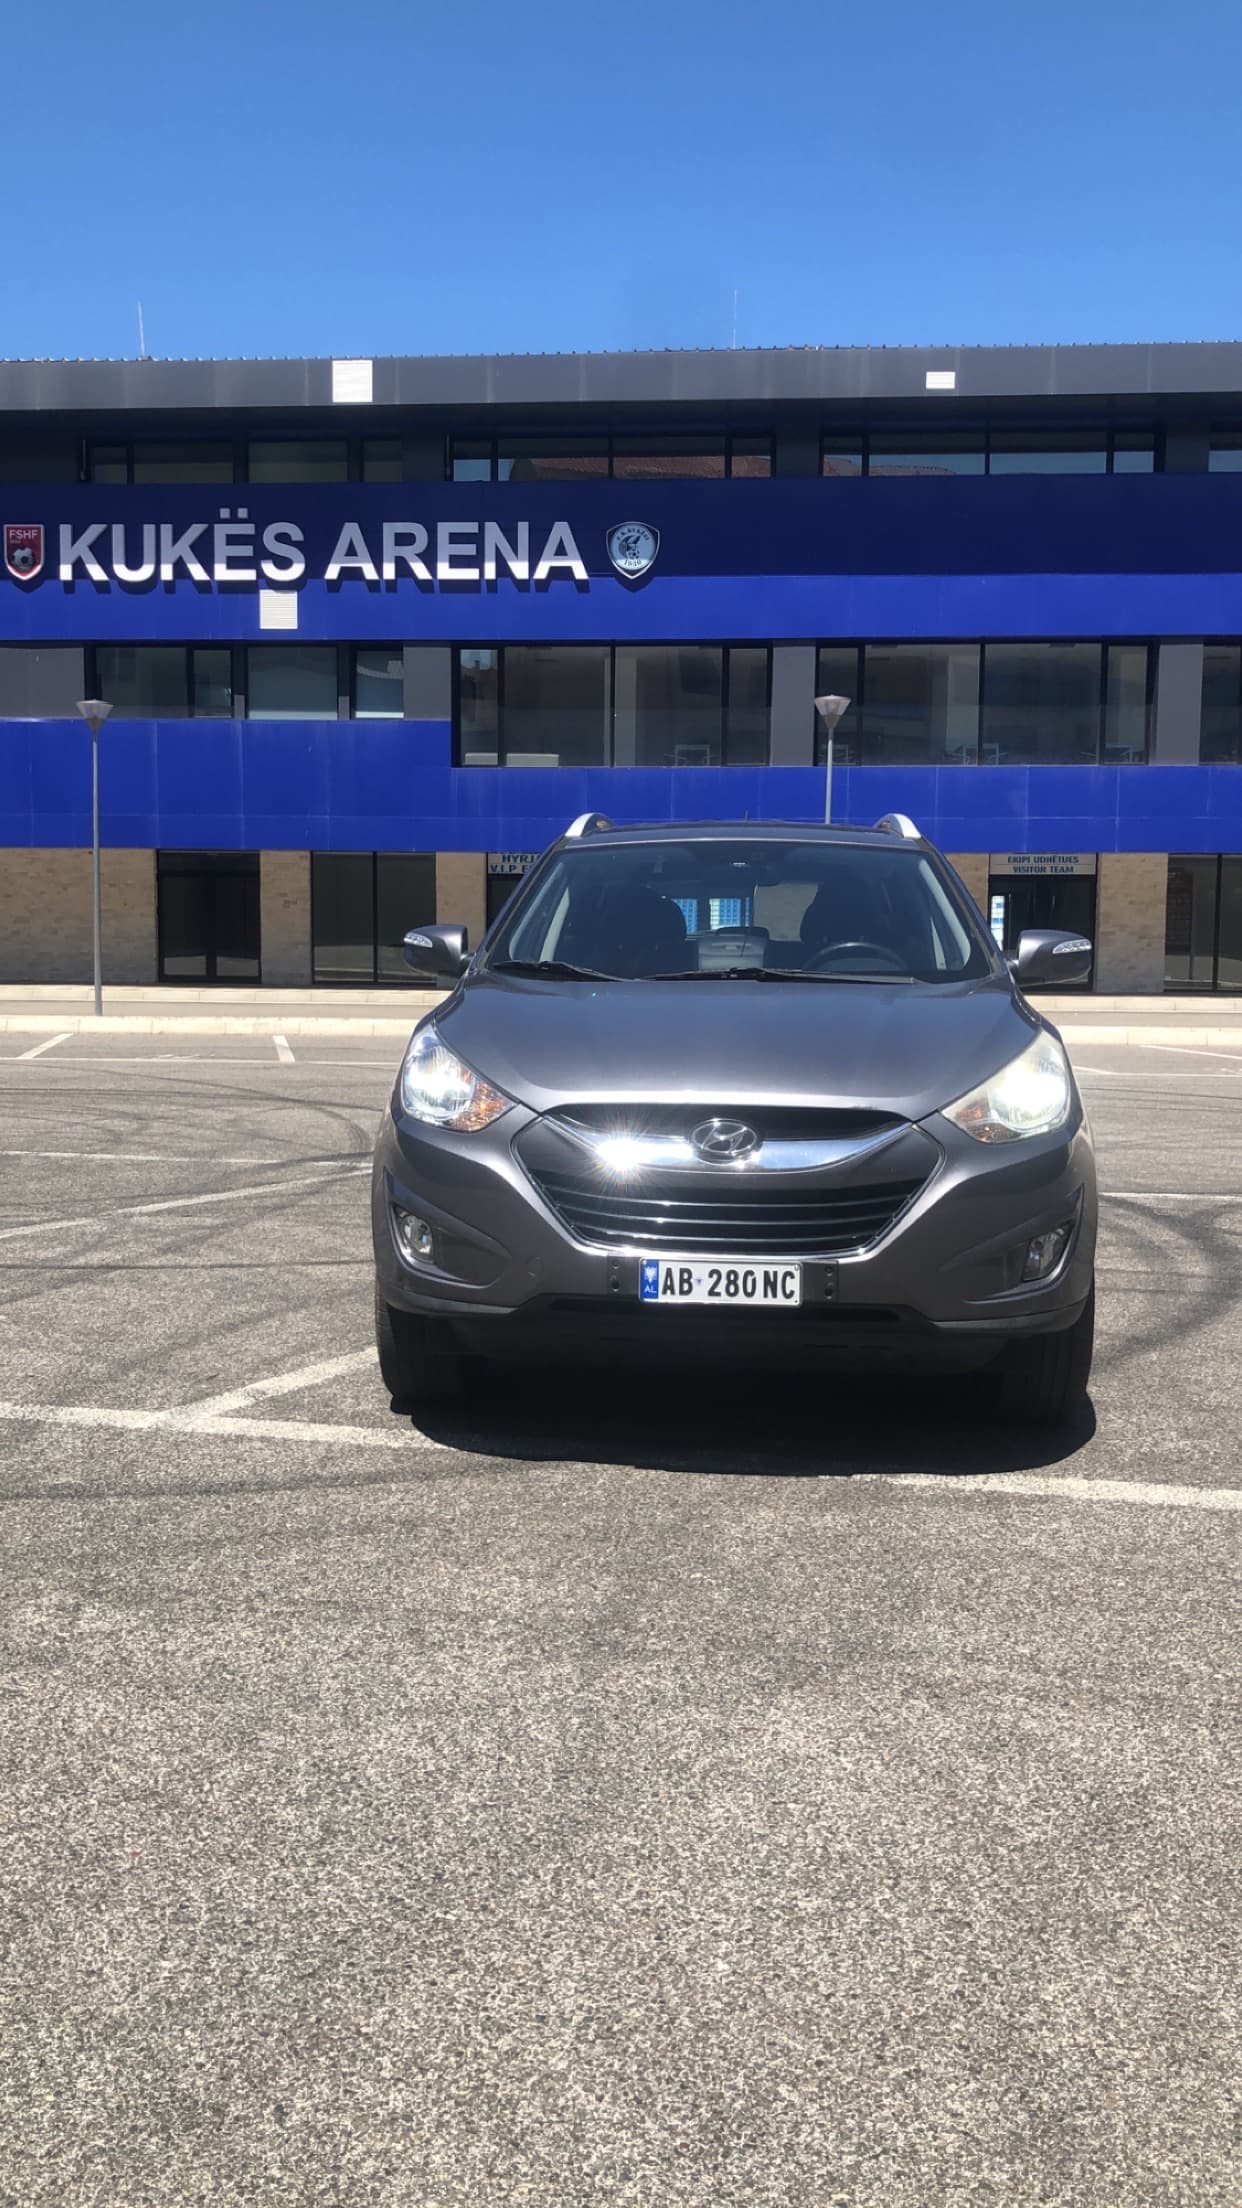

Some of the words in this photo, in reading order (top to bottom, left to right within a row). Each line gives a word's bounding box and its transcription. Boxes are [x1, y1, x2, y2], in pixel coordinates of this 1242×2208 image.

[9, 529, 39, 540] FSHF
[59, 507, 306, 582] KUKËS
[323, 521, 590, 581] ARENA
[502, 854, 540, 863] HYRJ
[1013, 865, 1047, 873] VISITOR
[1051, 865, 1074, 873] TEAM
[661, 1267, 693, 1296] AB
[644, 1285, 657, 1294] AL
